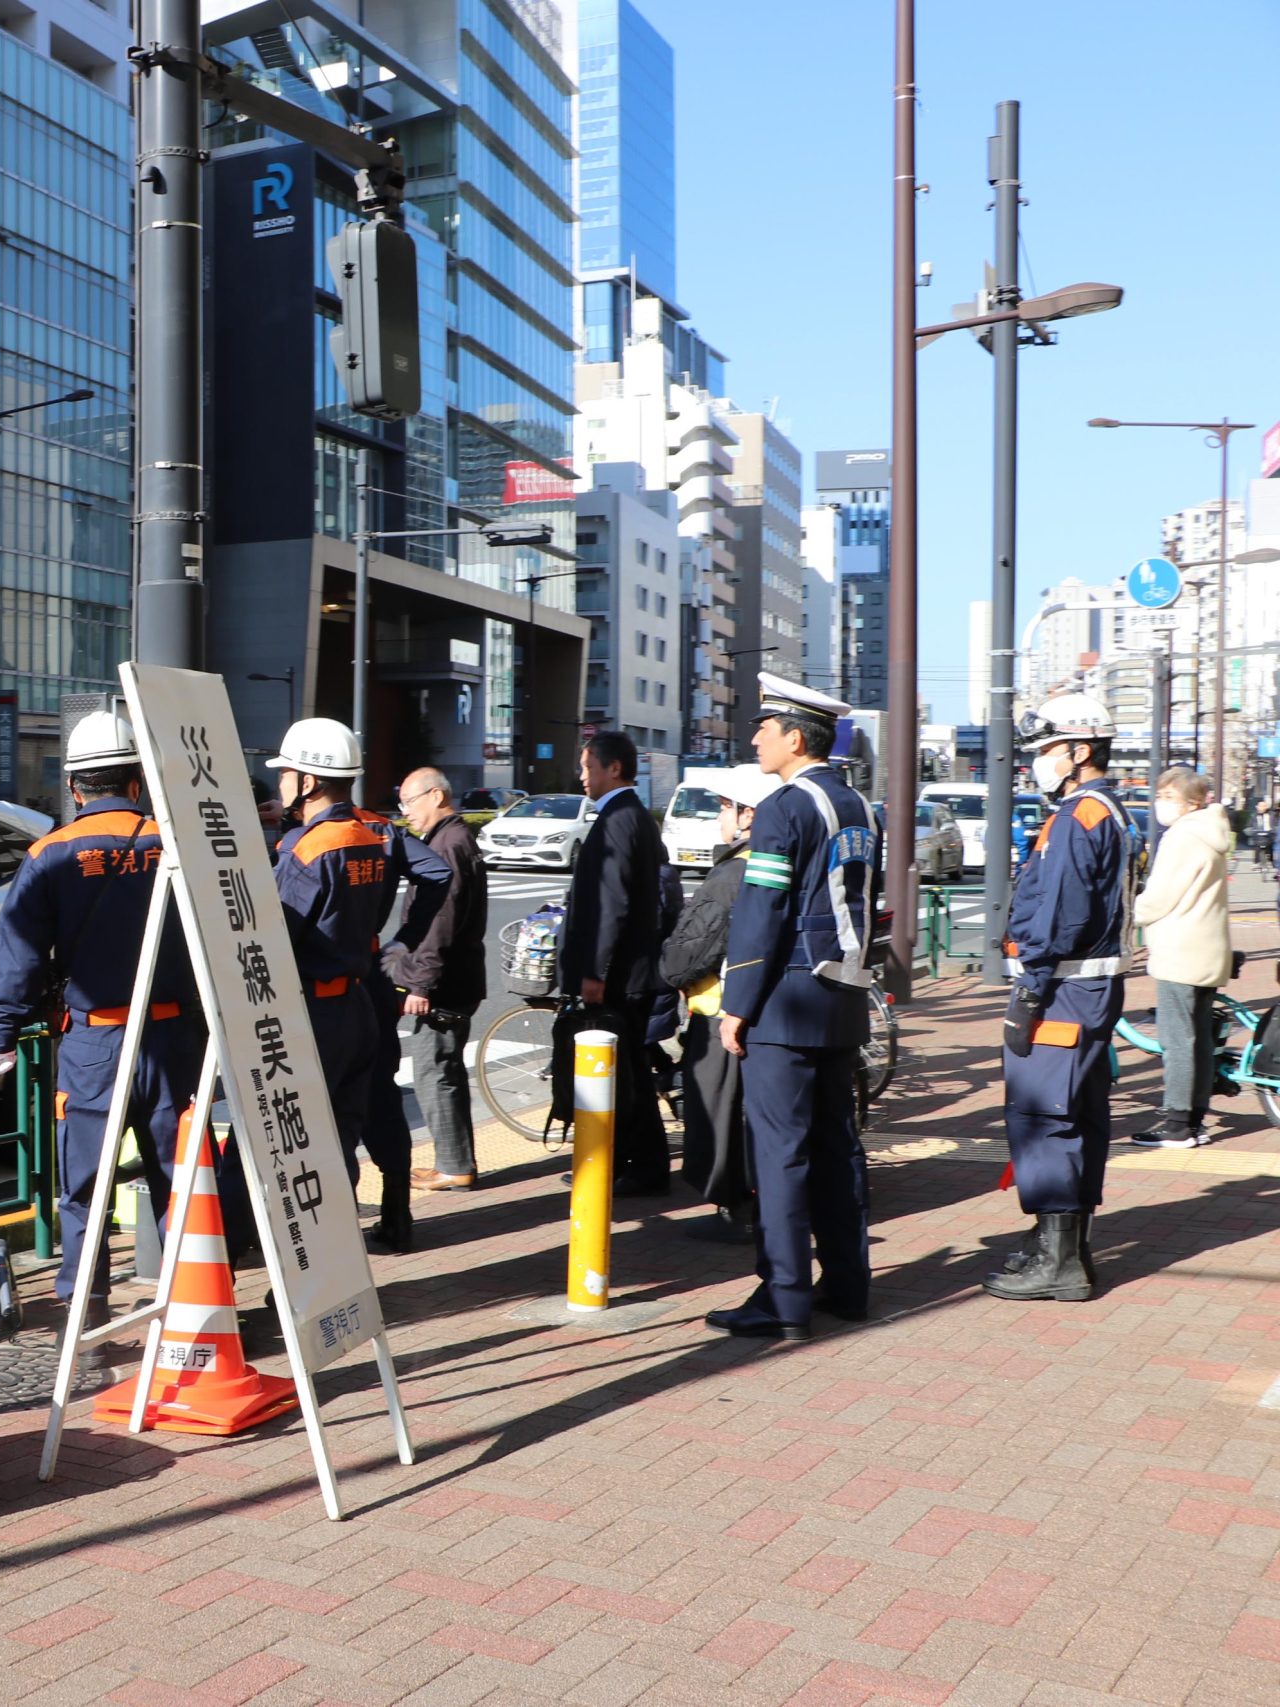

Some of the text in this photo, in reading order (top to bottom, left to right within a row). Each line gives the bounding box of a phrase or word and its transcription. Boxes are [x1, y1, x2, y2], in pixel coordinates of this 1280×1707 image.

[837, 830, 874, 860] 警視庁
[346, 858, 385, 886] 警視庁
[180, 725, 323, 1226] 災害訓練実施中
[319, 1303, 361, 1348] 警視庁
